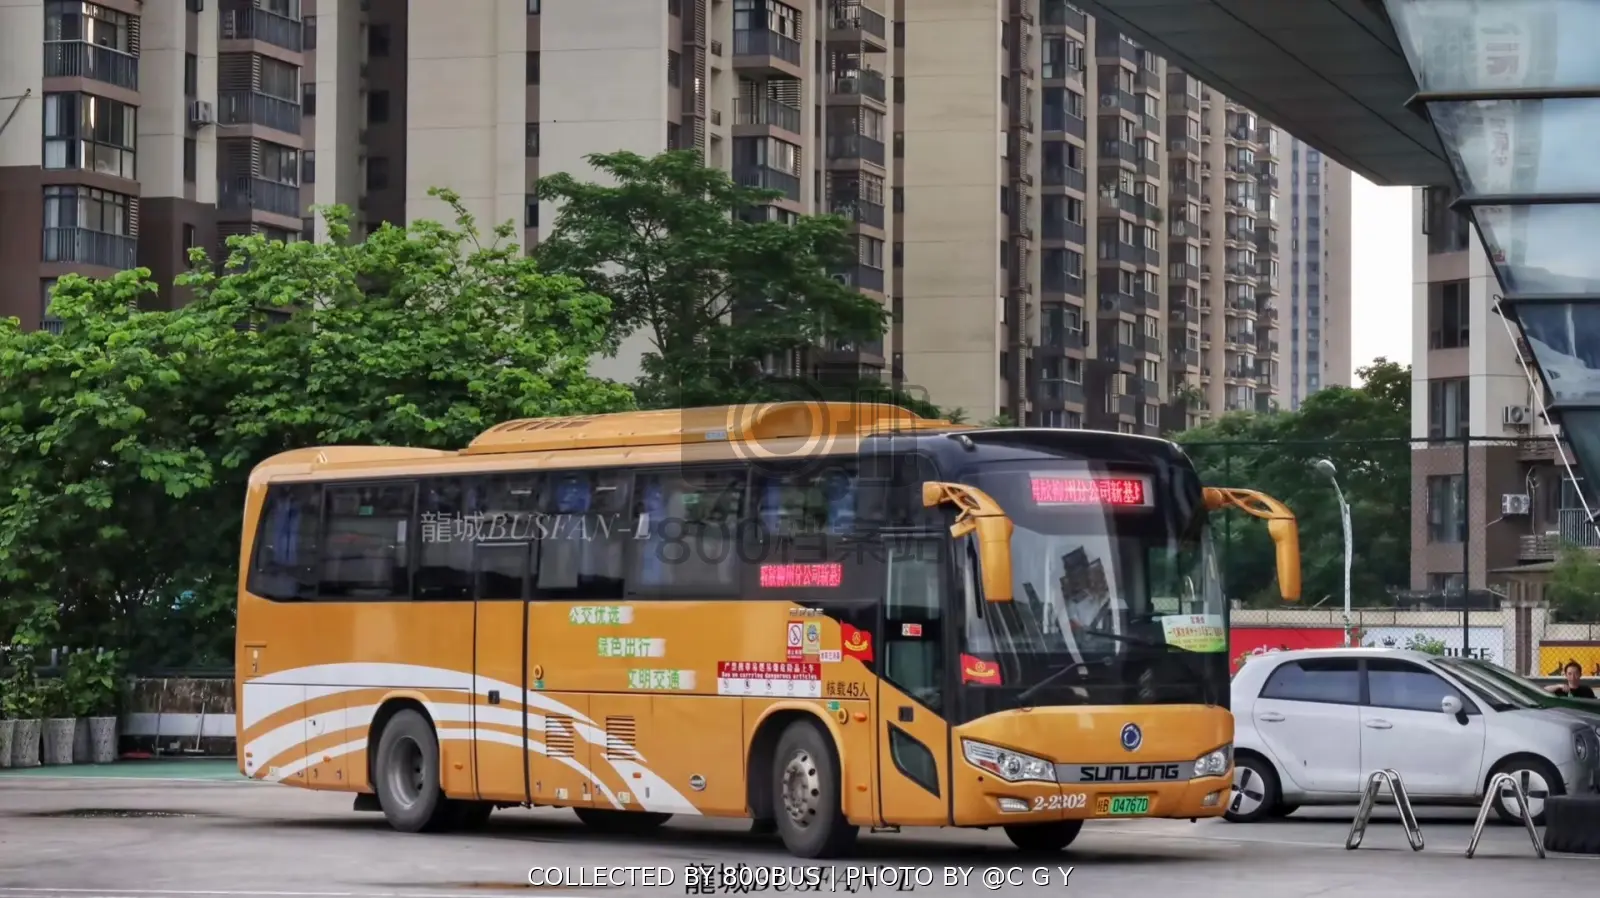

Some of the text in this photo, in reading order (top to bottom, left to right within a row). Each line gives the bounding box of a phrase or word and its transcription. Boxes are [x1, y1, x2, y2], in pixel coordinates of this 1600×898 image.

[628, 668, 680, 690] 文明交通
[826, 680, 869, 697] 核载45人
[1080, 764, 1179, 781] SUNLONG
[1034, 793, 1087, 811] 2-2302
